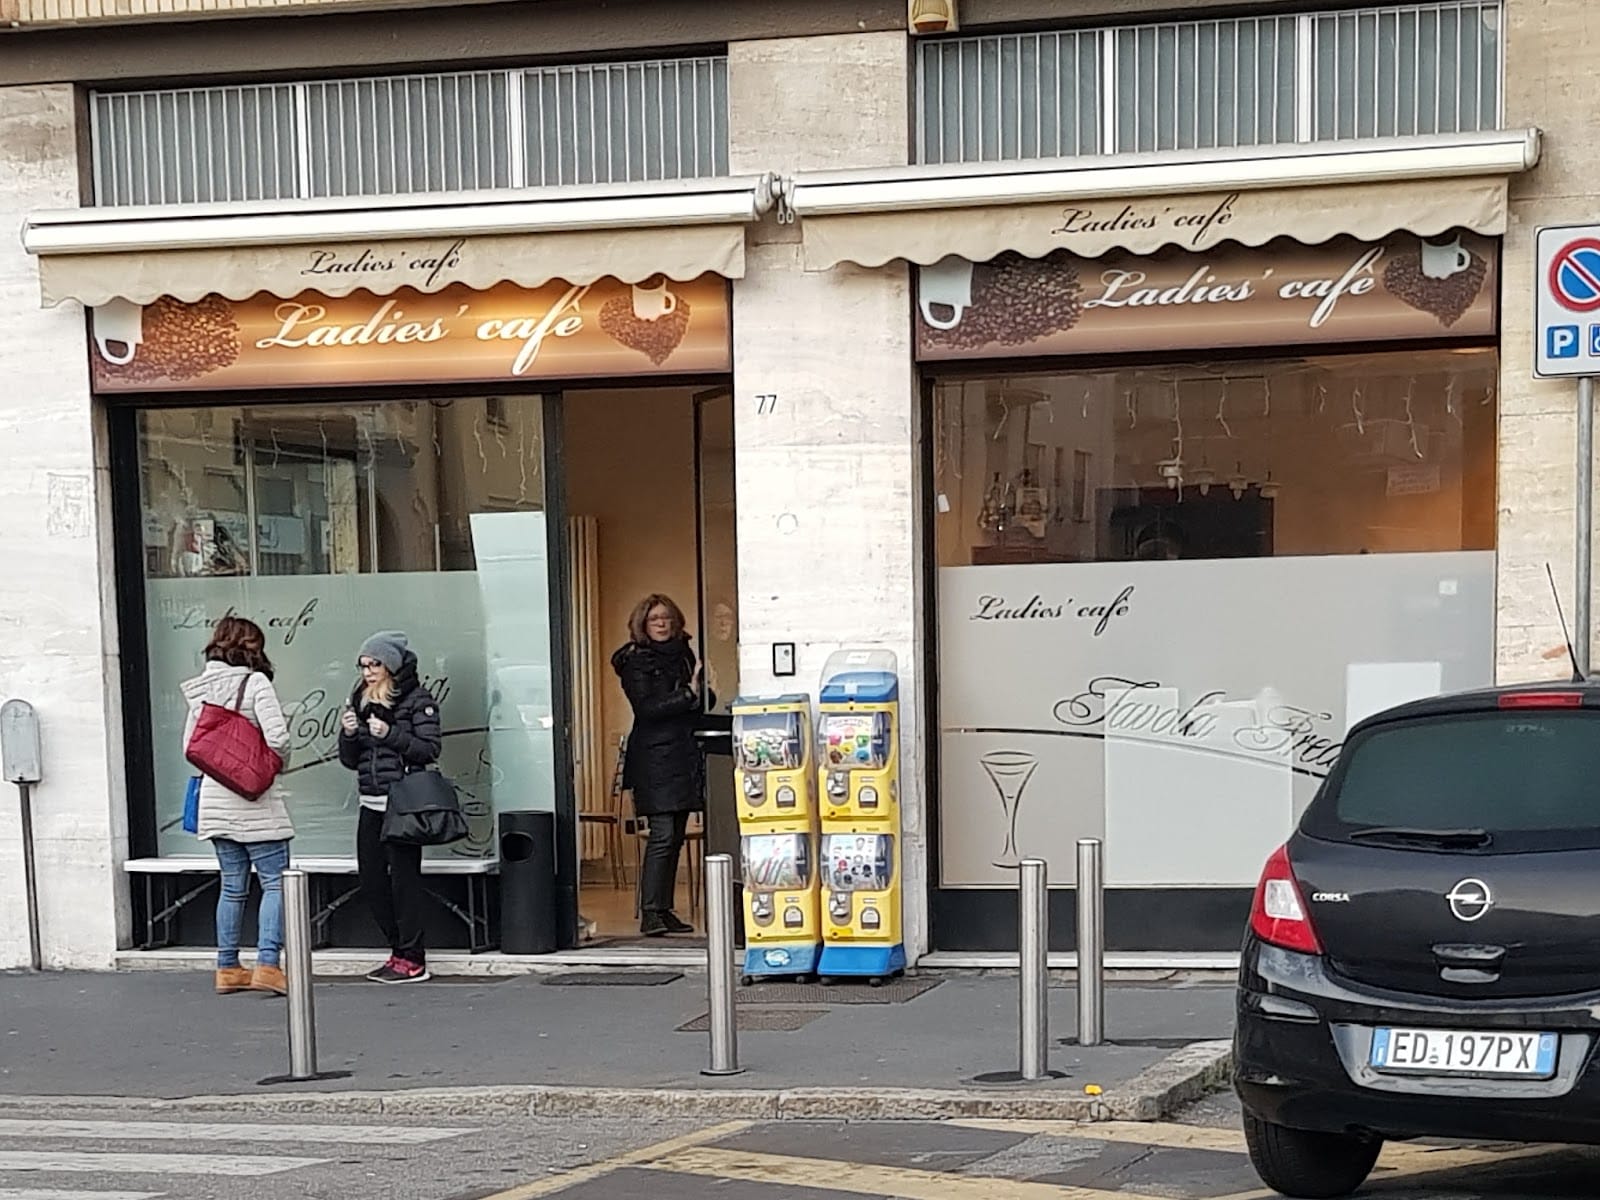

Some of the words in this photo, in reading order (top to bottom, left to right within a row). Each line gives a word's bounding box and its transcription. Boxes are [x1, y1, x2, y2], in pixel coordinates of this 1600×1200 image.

[1050, 205, 1170, 235] Ladies'
[300, 248, 405, 275] Ladies'
[1083, 265, 1273, 309] Ladies'
[256, 299, 469, 348] Ladies'
[1553, 329, 1574, 356] P
[754, 394, 777, 415] 77
[1052, 676, 1227, 738] Tavola
[1312, 892, 1350, 902] CORSA
